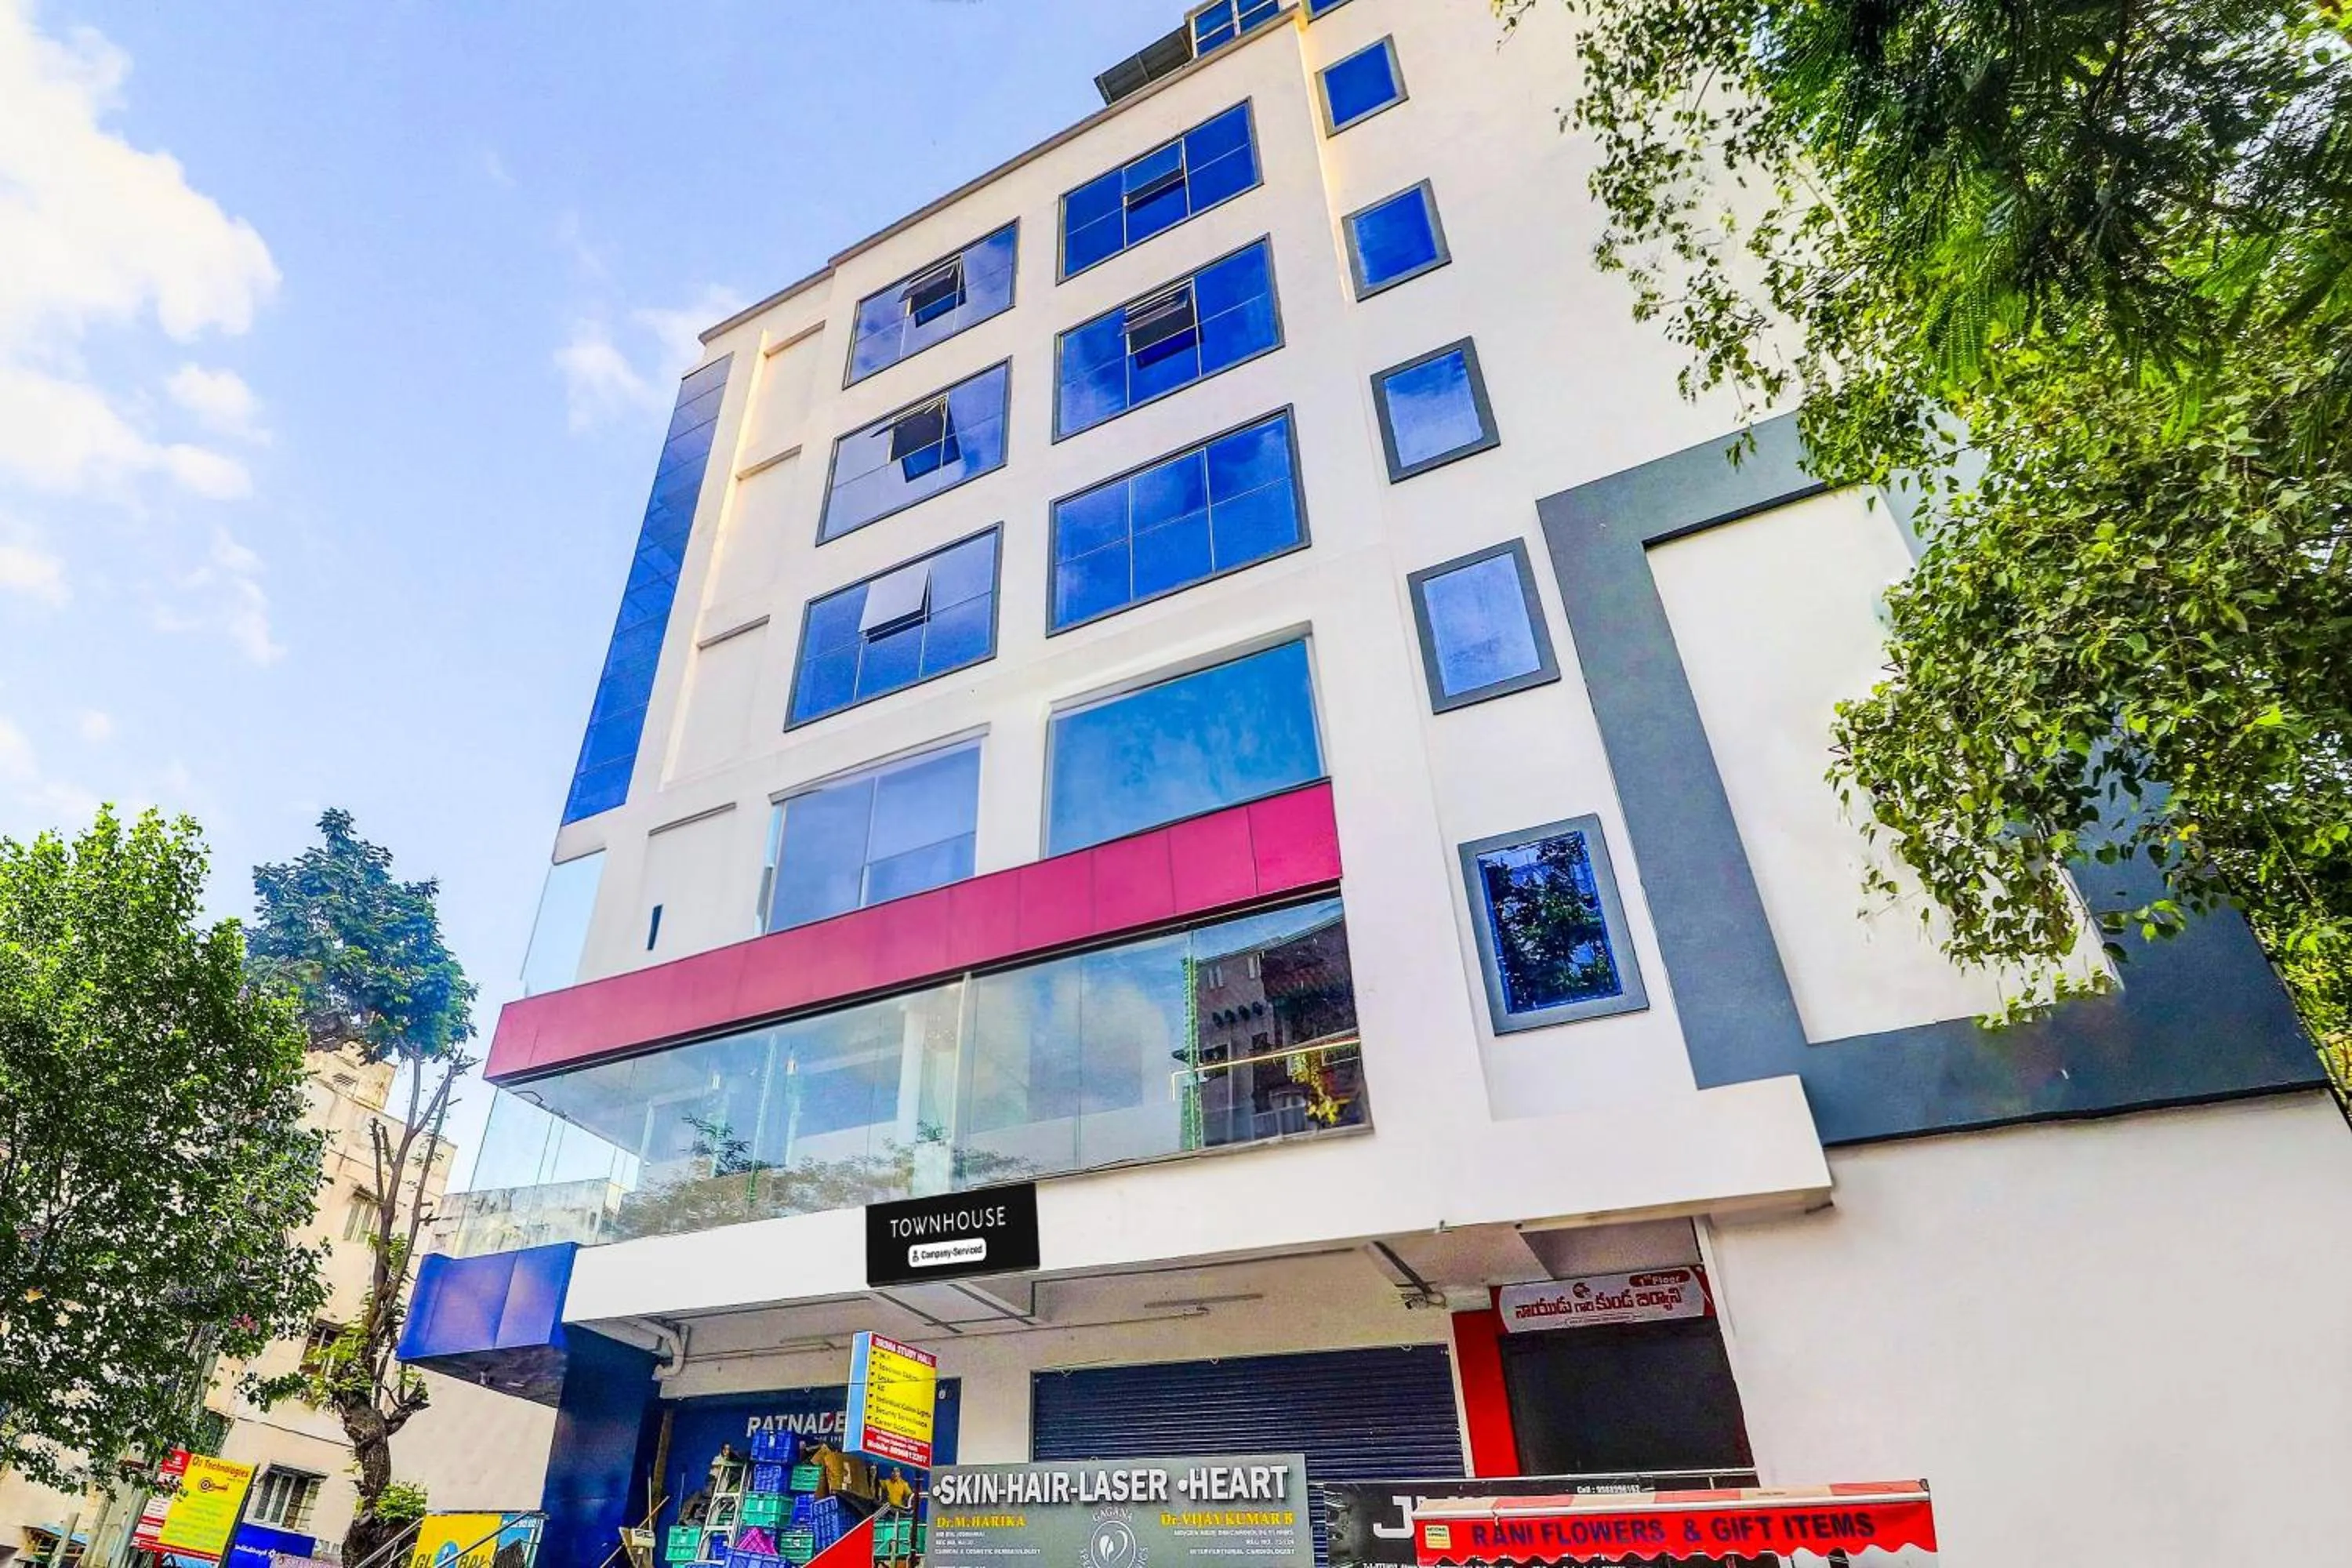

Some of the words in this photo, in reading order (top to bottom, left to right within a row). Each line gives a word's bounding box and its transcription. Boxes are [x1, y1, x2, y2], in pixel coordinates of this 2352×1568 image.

[890, 1206, 1007, 1238] TOWNHOUSE
[920, 1244, 983, 1259] Company-Serviced
[1653, 1276, 1681, 1285] Floor
[746, 1412, 848, 1438] RATNADE
[1189, 1465, 1288, 1500] HEART
[1225, 1512, 1279, 1526] KUMAR
[1472, 1524, 1534, 1548] RANI
[1541, 1519, 1666, 1544] FLOWERS
[1683, 1518, 1701, 1542] &
[1711, 1516, 1772, 1542] GIFT
[1784, 1512, 1875, 1540] ITEMS
